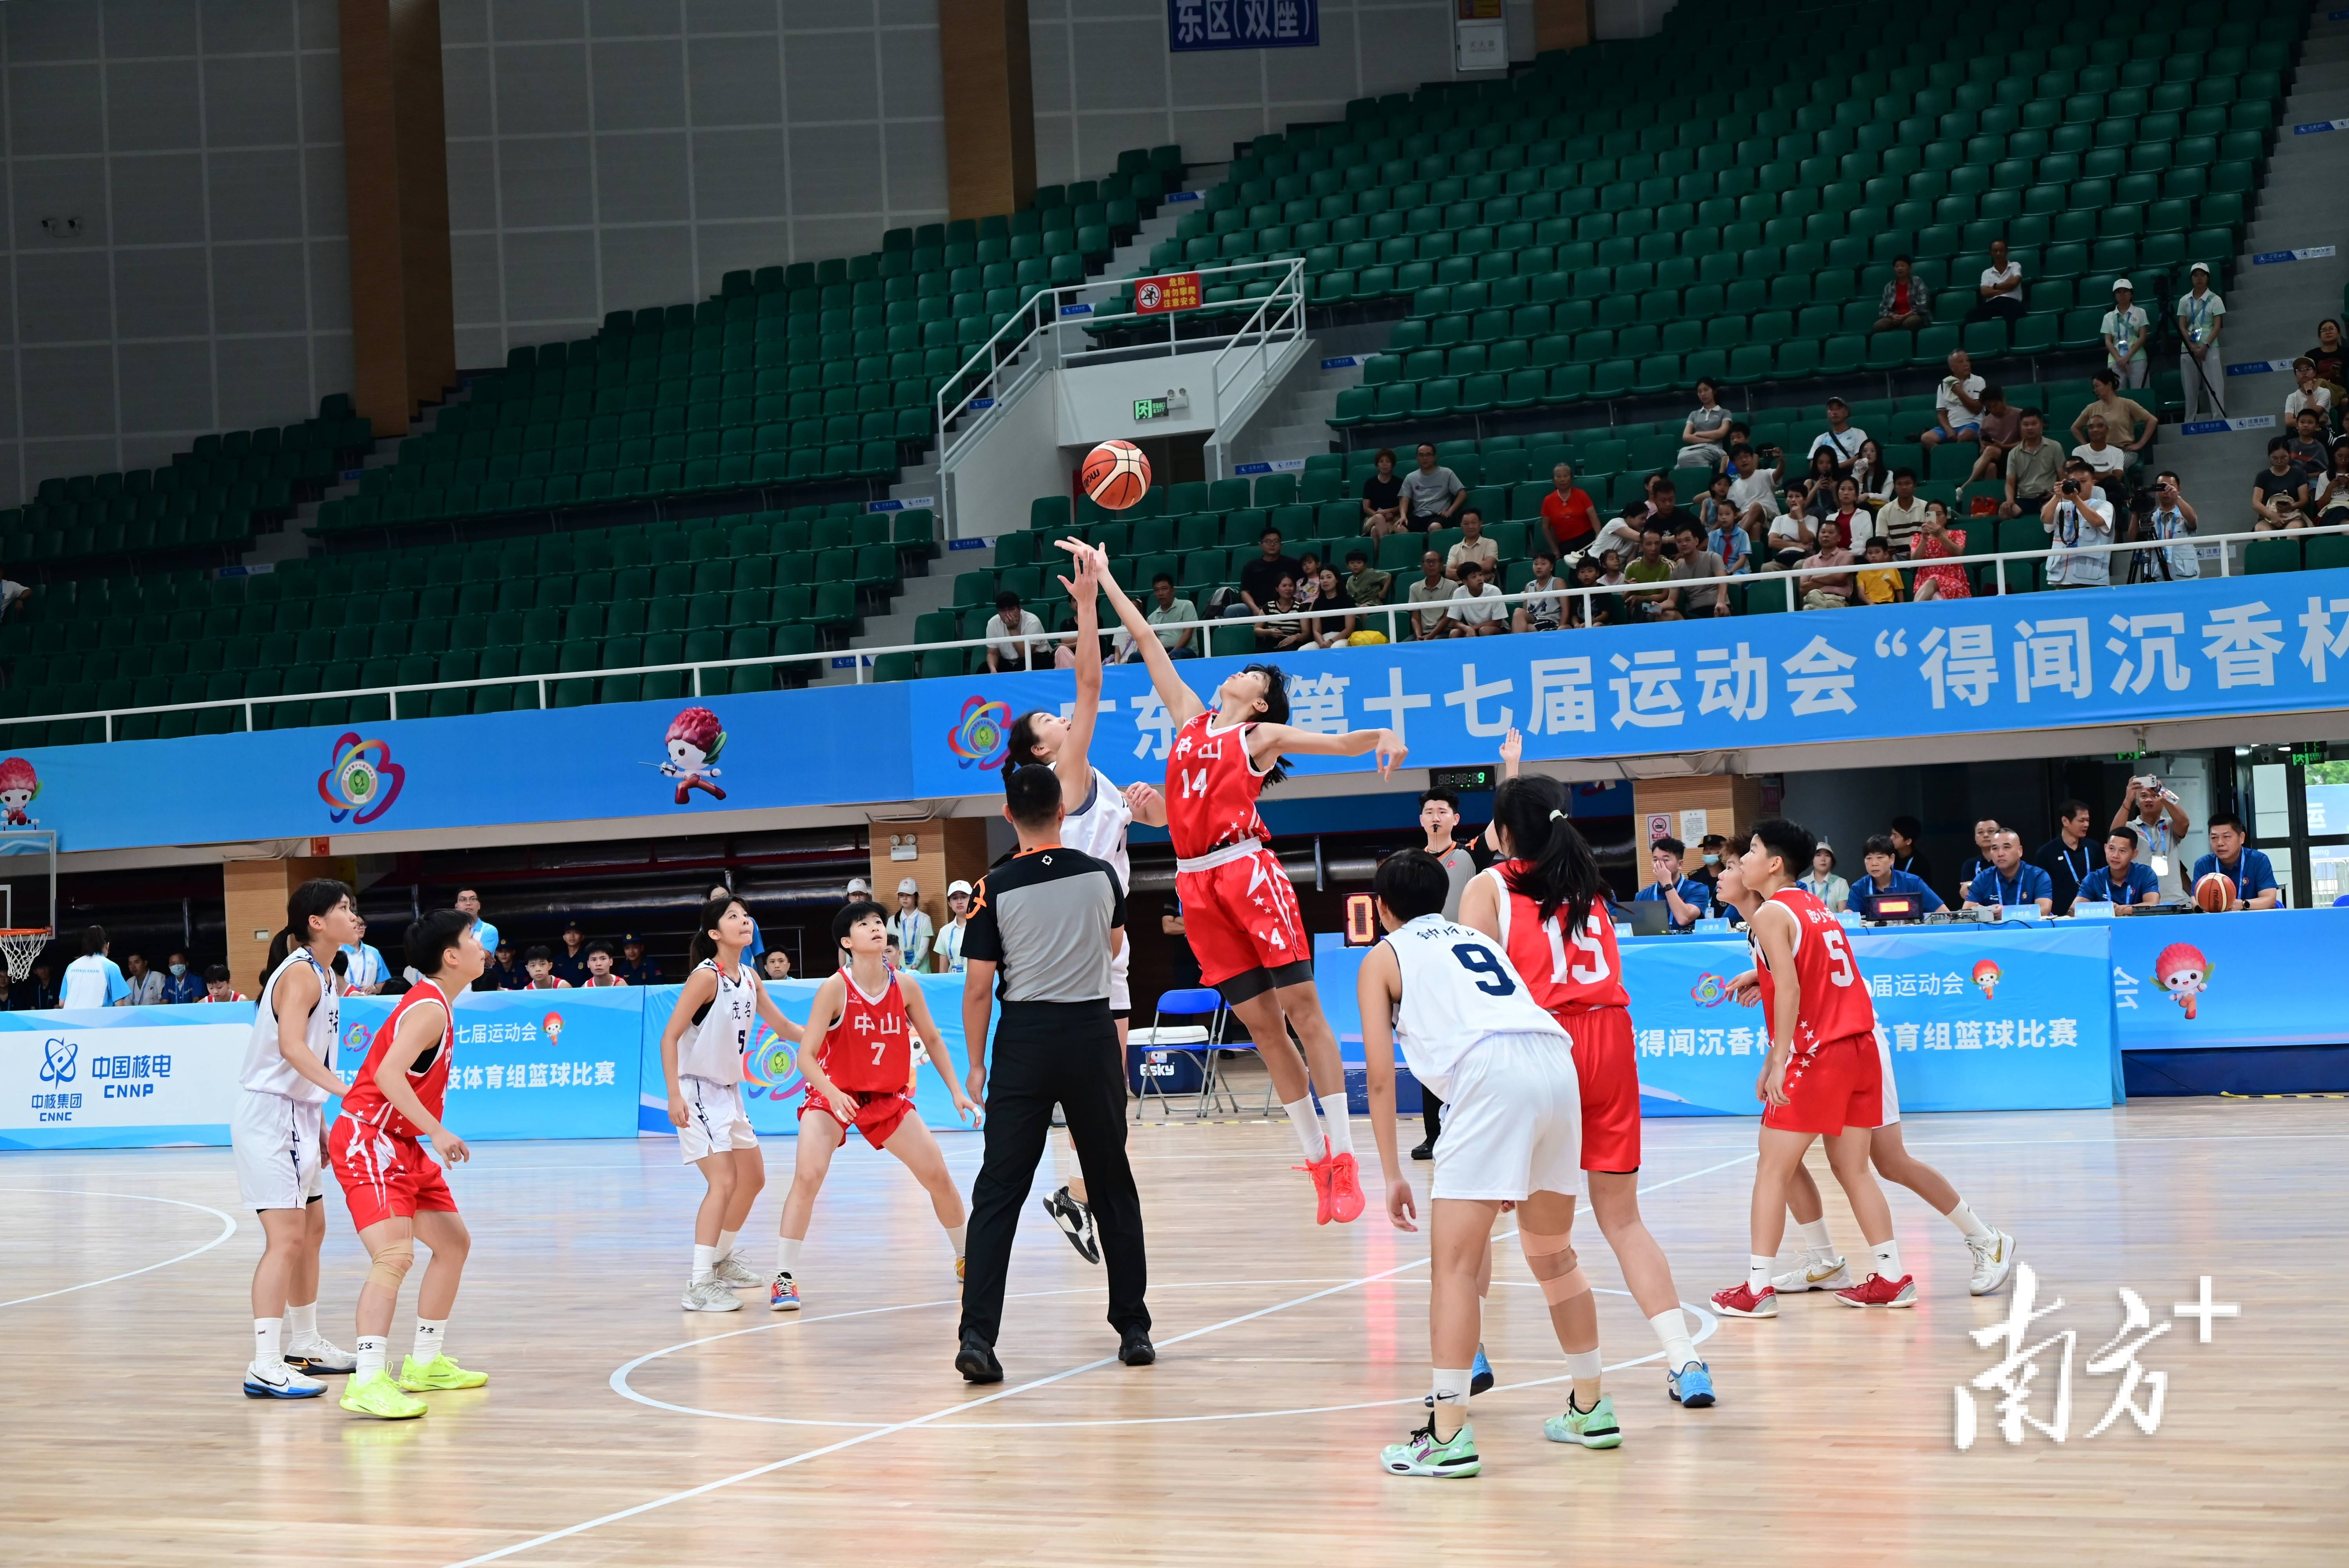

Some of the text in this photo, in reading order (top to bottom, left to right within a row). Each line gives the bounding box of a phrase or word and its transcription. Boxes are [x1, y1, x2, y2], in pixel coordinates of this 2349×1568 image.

[1163, 286, 1196, 298] 请勿攀爬
[1164, 296, 1196, 307] 注意安全
[1176, 735, 1222, 760] 中山
[1181, 768, 1208, 799] 14
[1542, 915, 1610, 985] 15
[1822, 929, 1855, 987] 5
[1451, 943, 1516, 996] 9
[732, 1000, 751, 1020] 茂名
[854, 1013, 901, 1036] 中山
[738, 1029, 746, 1055] 5
[871, 1042, 886, 1065] 7
[92, 1054, 171, 1079] 中国核电
[32, 1093, 82, 1109] 中核集团
[104, 1083, 153, 1098] CNNP
[40, 1112, 72, 1122] CNNC
